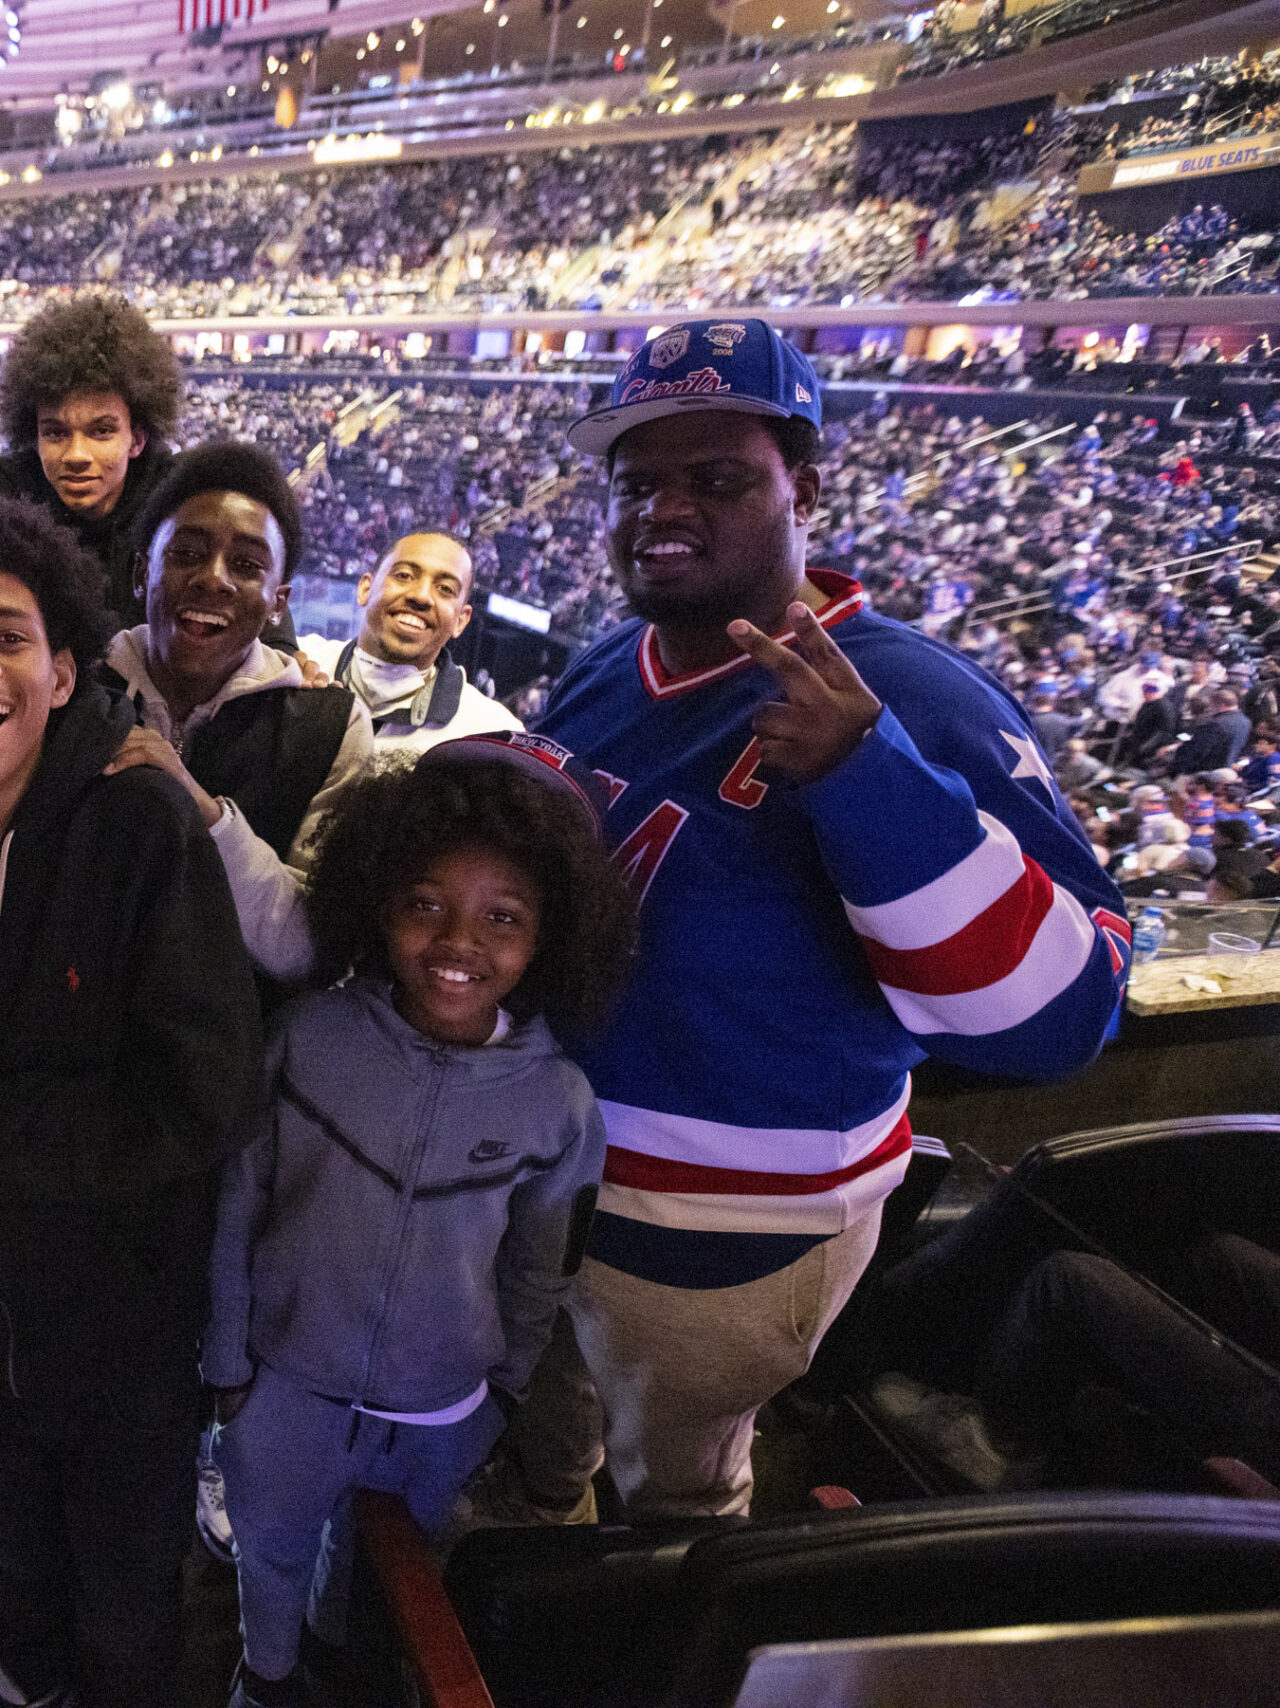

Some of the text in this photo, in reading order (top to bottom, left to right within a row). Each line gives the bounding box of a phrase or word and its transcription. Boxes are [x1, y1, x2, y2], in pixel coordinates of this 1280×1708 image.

[1181, 147, 1261, 173] BLUE SEATS
[620, 365, 732, 404] Giants
[514, 735, 565, 761] NEW YORK
